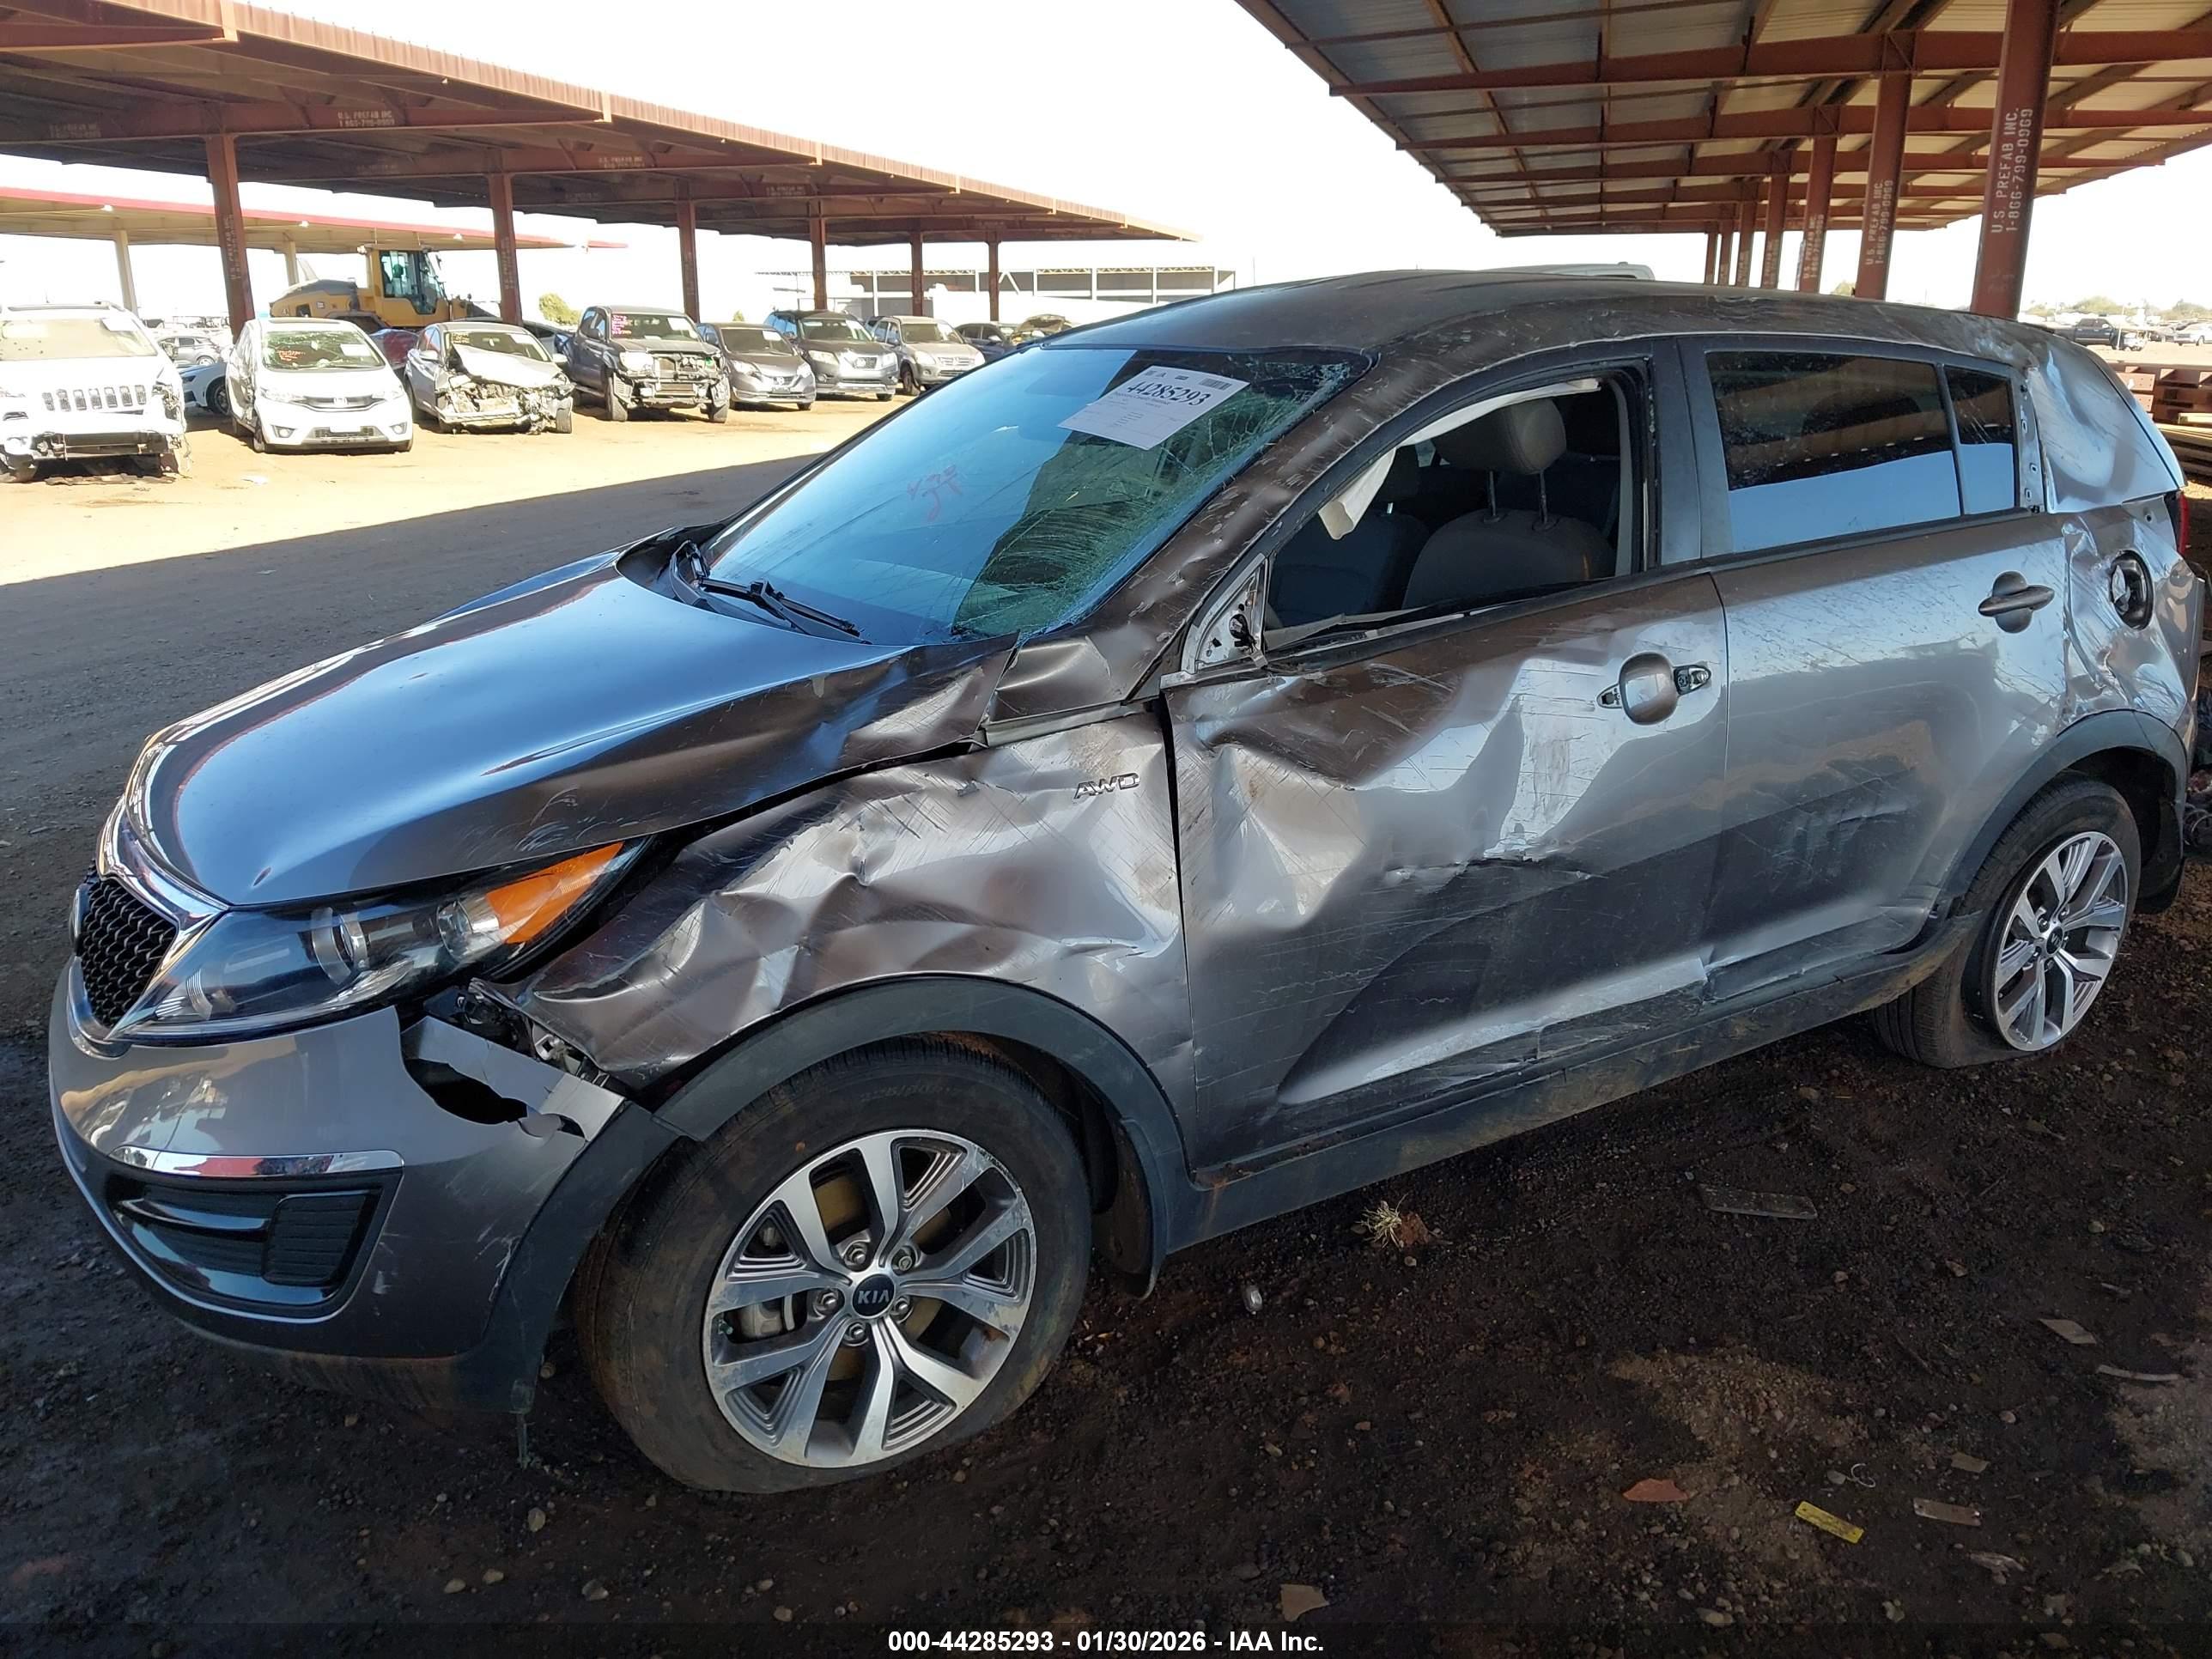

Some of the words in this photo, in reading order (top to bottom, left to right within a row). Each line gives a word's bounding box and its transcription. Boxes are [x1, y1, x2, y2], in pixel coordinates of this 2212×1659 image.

[2003, 108, 2019, 136] INC.
[1996, 143, 2014, 198] PREFAB
[2006, 108, 2033, 232] 1-866-799-0969
[1127, 381, 1212, 406] 44285293
[1073, 772, 1140, 799] AWD
[857, 1289, 890, 1304] KIA
